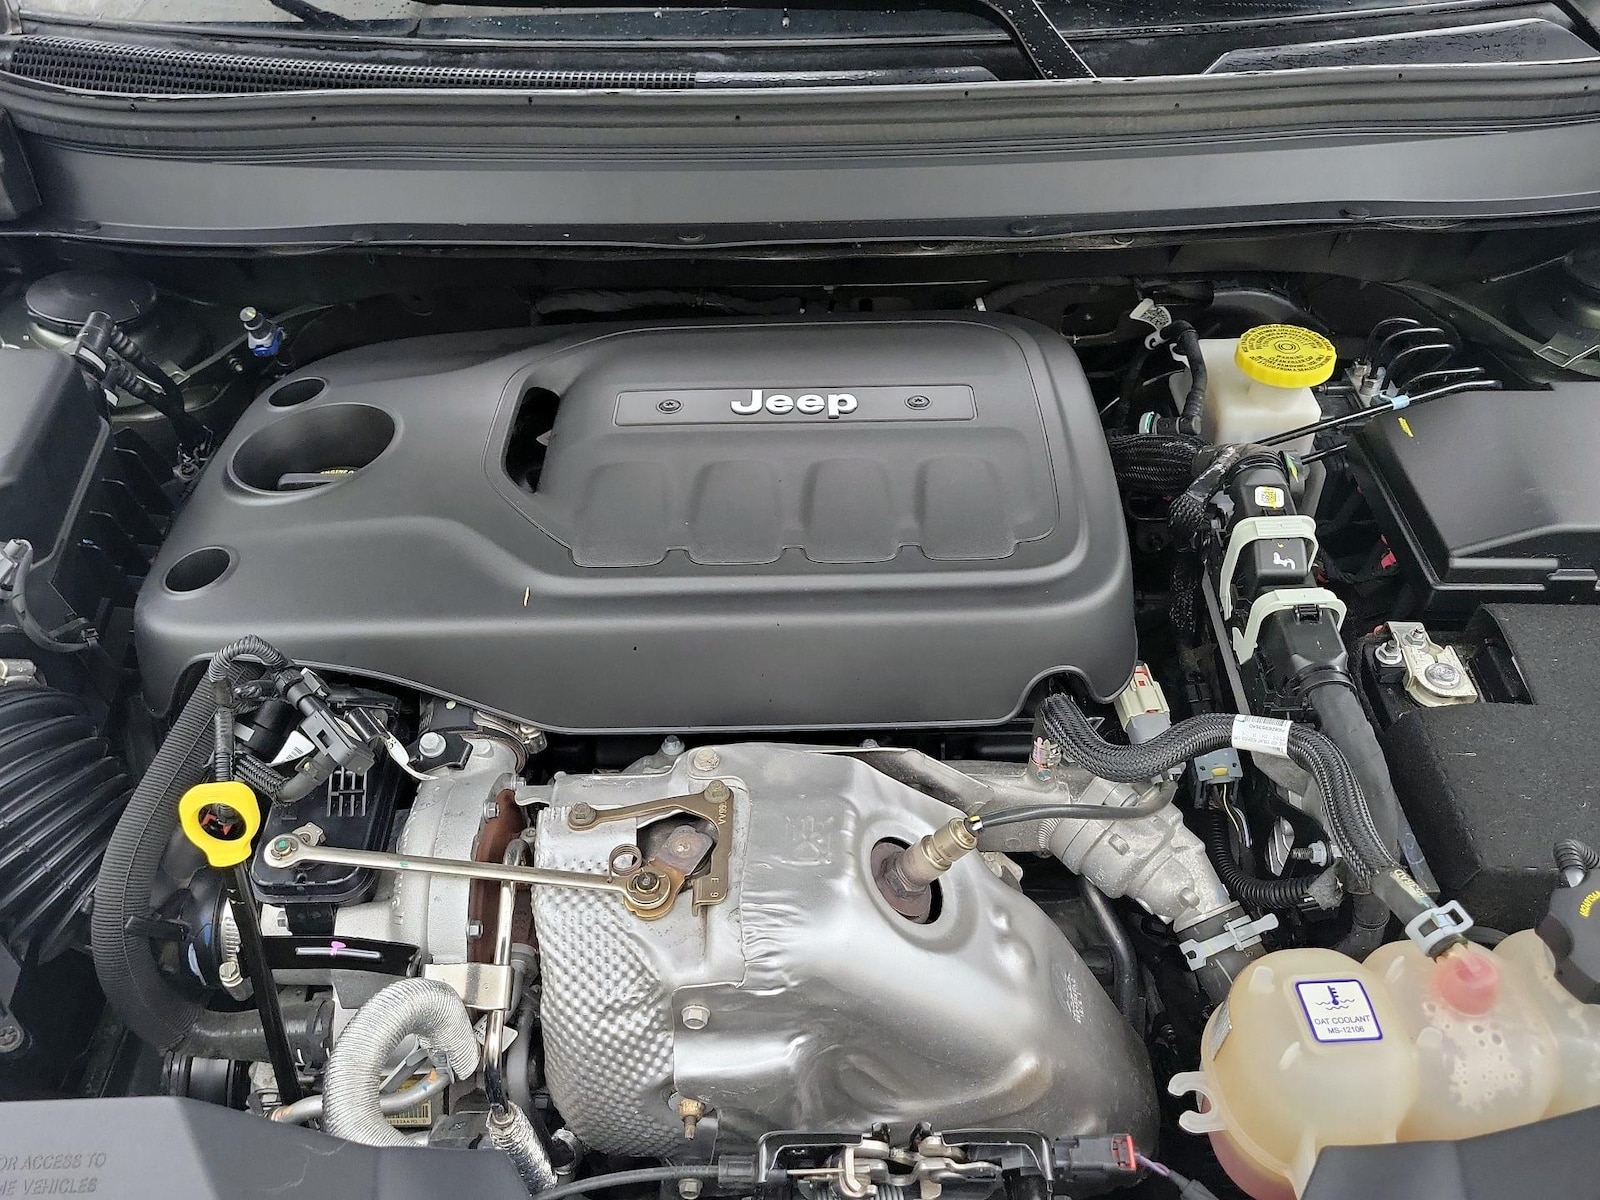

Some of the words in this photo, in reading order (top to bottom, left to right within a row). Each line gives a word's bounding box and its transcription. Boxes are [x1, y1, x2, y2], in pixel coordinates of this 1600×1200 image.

[730, 389, 858, 419] Jeep
[1314, 1016, 1330, 1025] OAT
[1331, 1015, 1370, 1025] COOLANT
[1327, 1026, 1365, 1034] MS-12106
[20, 1153, 82, 1171] ACCESS
[87, 1152, 107, 1169] TO
[24, 1177, 98, 1195] VEHICLES
